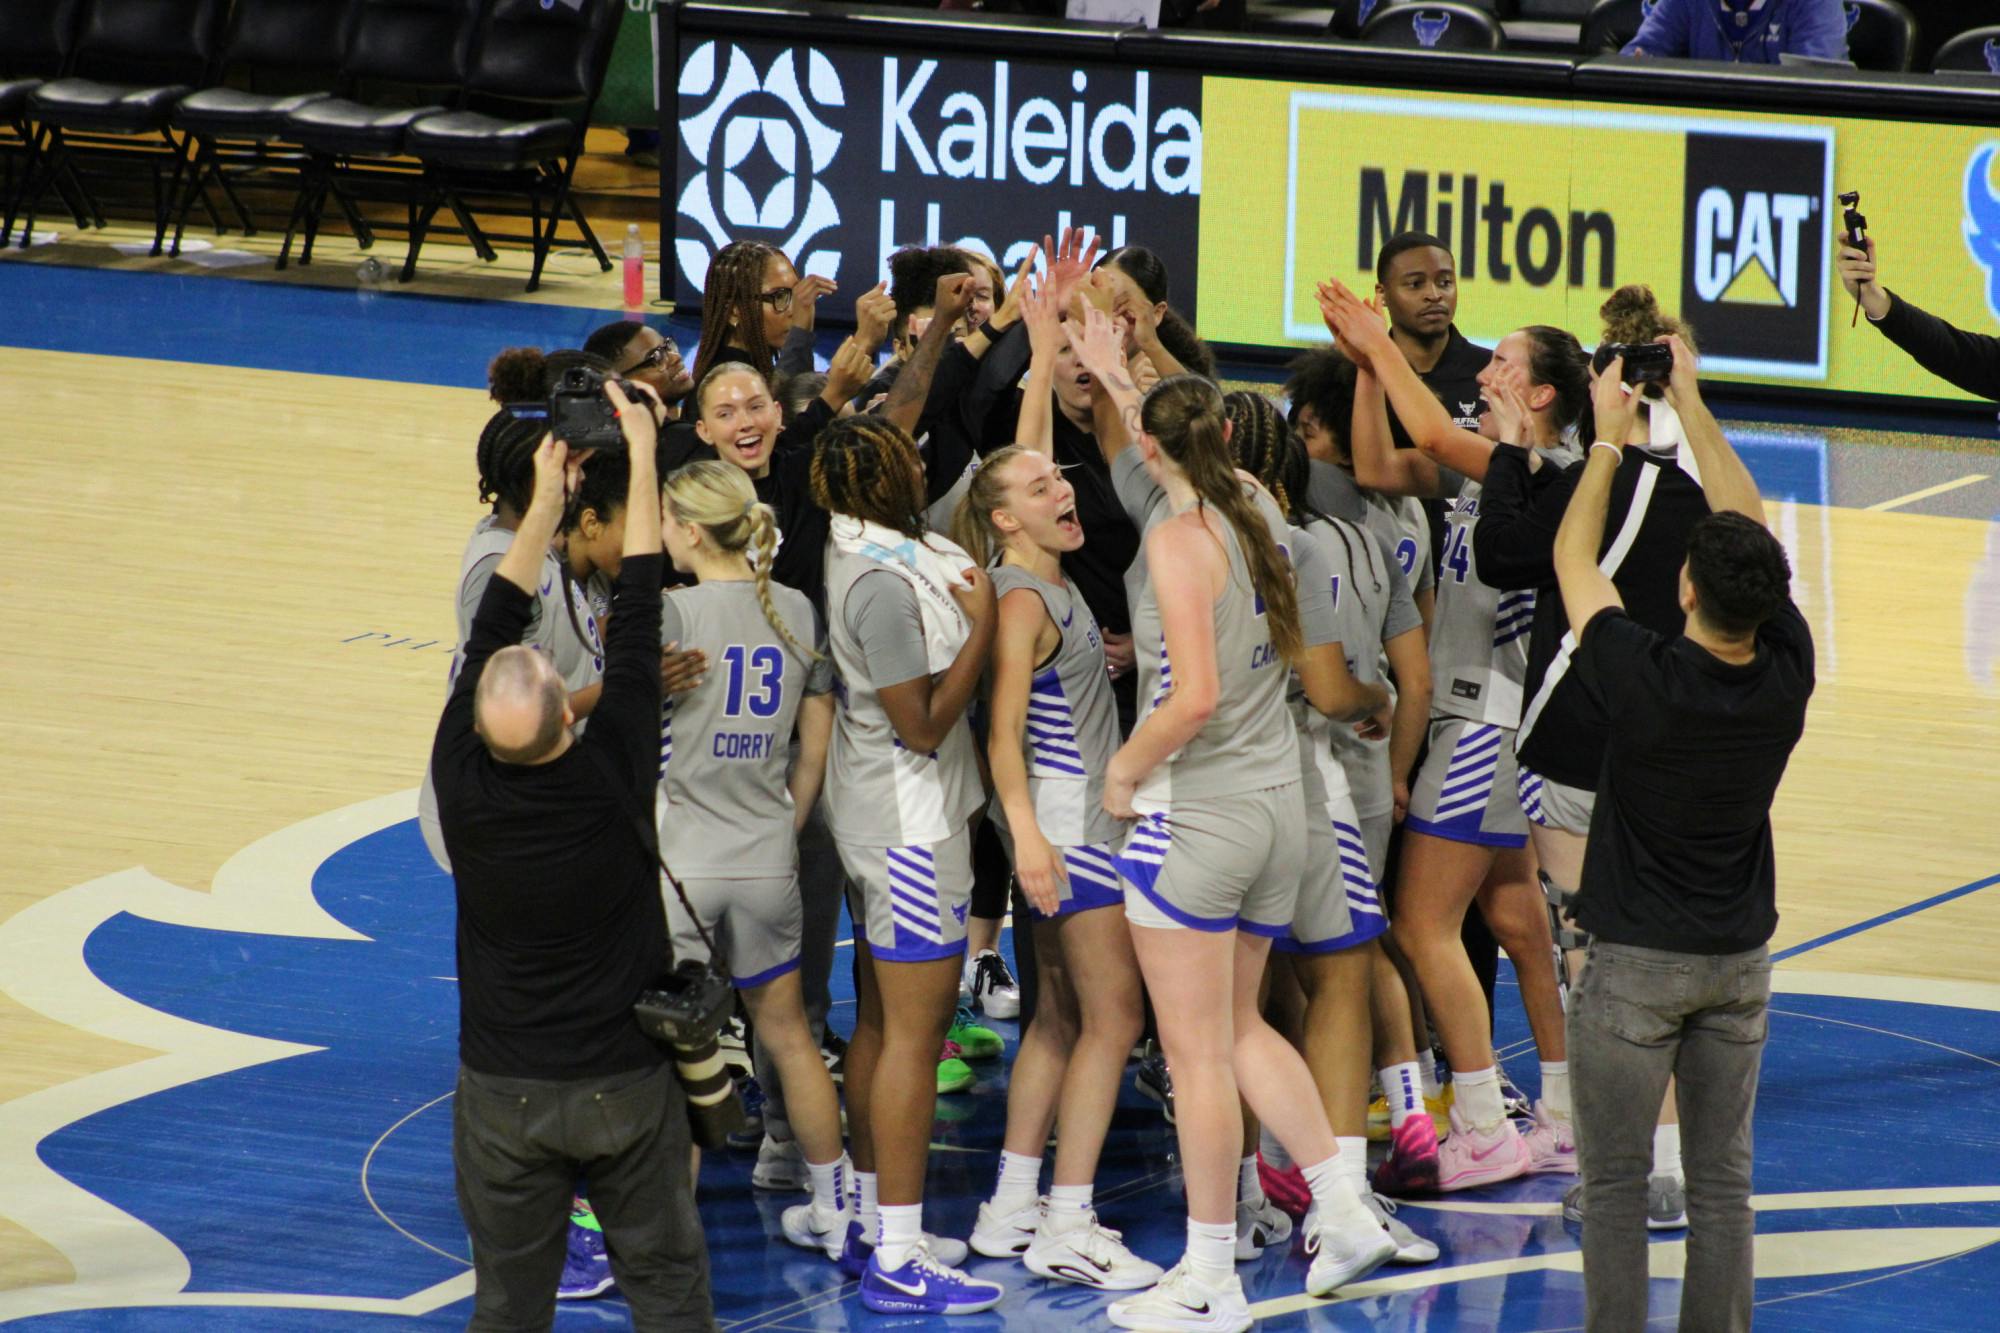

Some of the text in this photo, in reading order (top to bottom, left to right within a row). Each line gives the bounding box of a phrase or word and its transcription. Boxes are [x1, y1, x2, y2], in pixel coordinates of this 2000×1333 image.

[880, 56, 1201, 195] Kaleida
[1358, 166, 1616, 289] Milton
[1694, 186, 1811, 309] CAT
[720, 644, 784, 718] 13
[713, 732, 774, 759] CORRY
